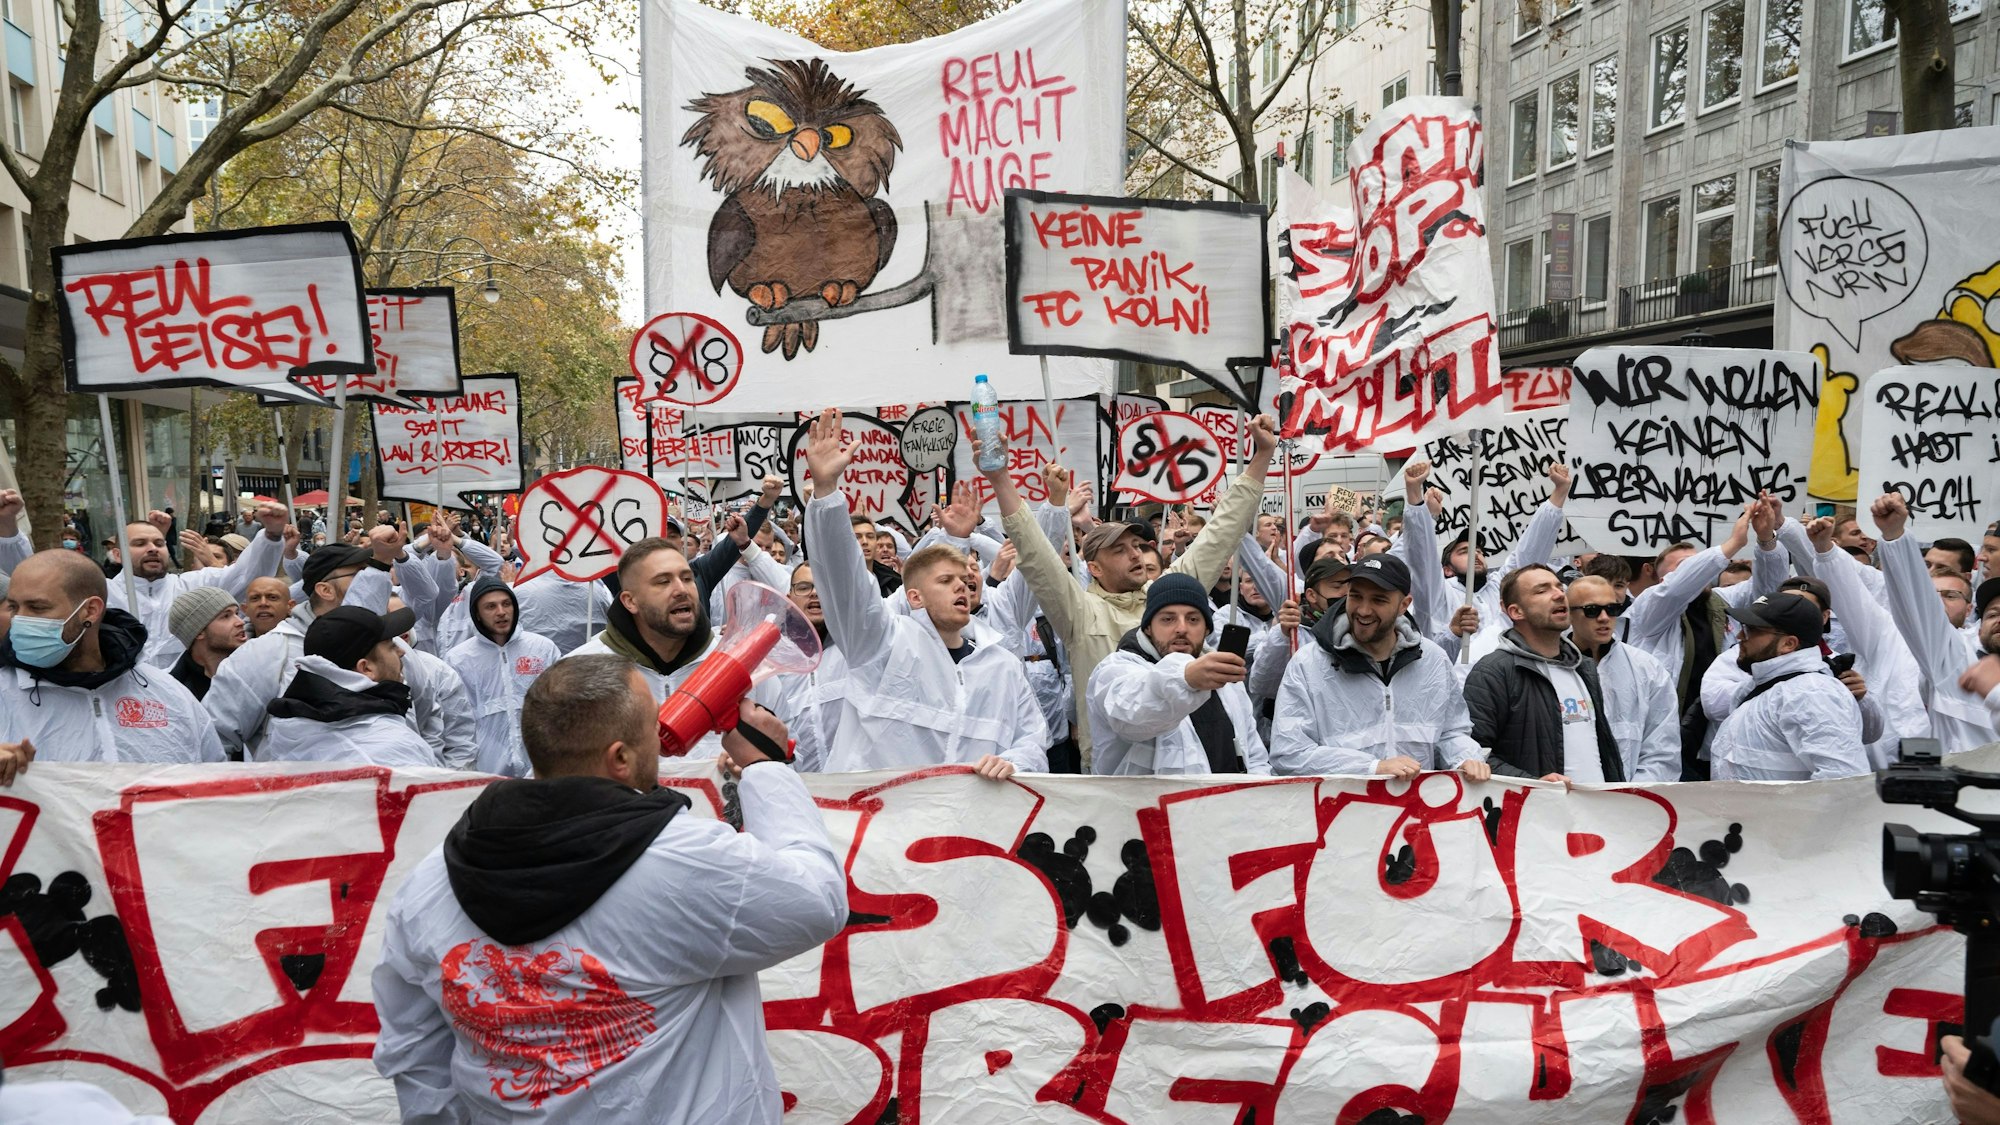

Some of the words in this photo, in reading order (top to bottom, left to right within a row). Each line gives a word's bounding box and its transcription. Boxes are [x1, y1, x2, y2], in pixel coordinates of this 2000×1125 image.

[942, 47, 1066, 103] REUL
[939, 85, 1078, 158] MACHT
[1798, 197, 1882, 240] FUCK
[65, 257, 254, 337] REUL
[1805, 267, 1908, 301] NRW
[124, 282, 338, 374] LEISE!
[1023, 291, 1084, 329] FC
[1103, 286, 1210, 335] KÖLN!
[1503, 367, 1573, 403] FÜR
[405, 420, 466, 439] STATT
[1891, 431, 1973, 469] HABT
[381, 442, 413, 463] LAW
[421, 441, 438, 463] &
[1882, 474, 1982, 523] RSCH
[1608, 510, 1728, 548] STAAT
